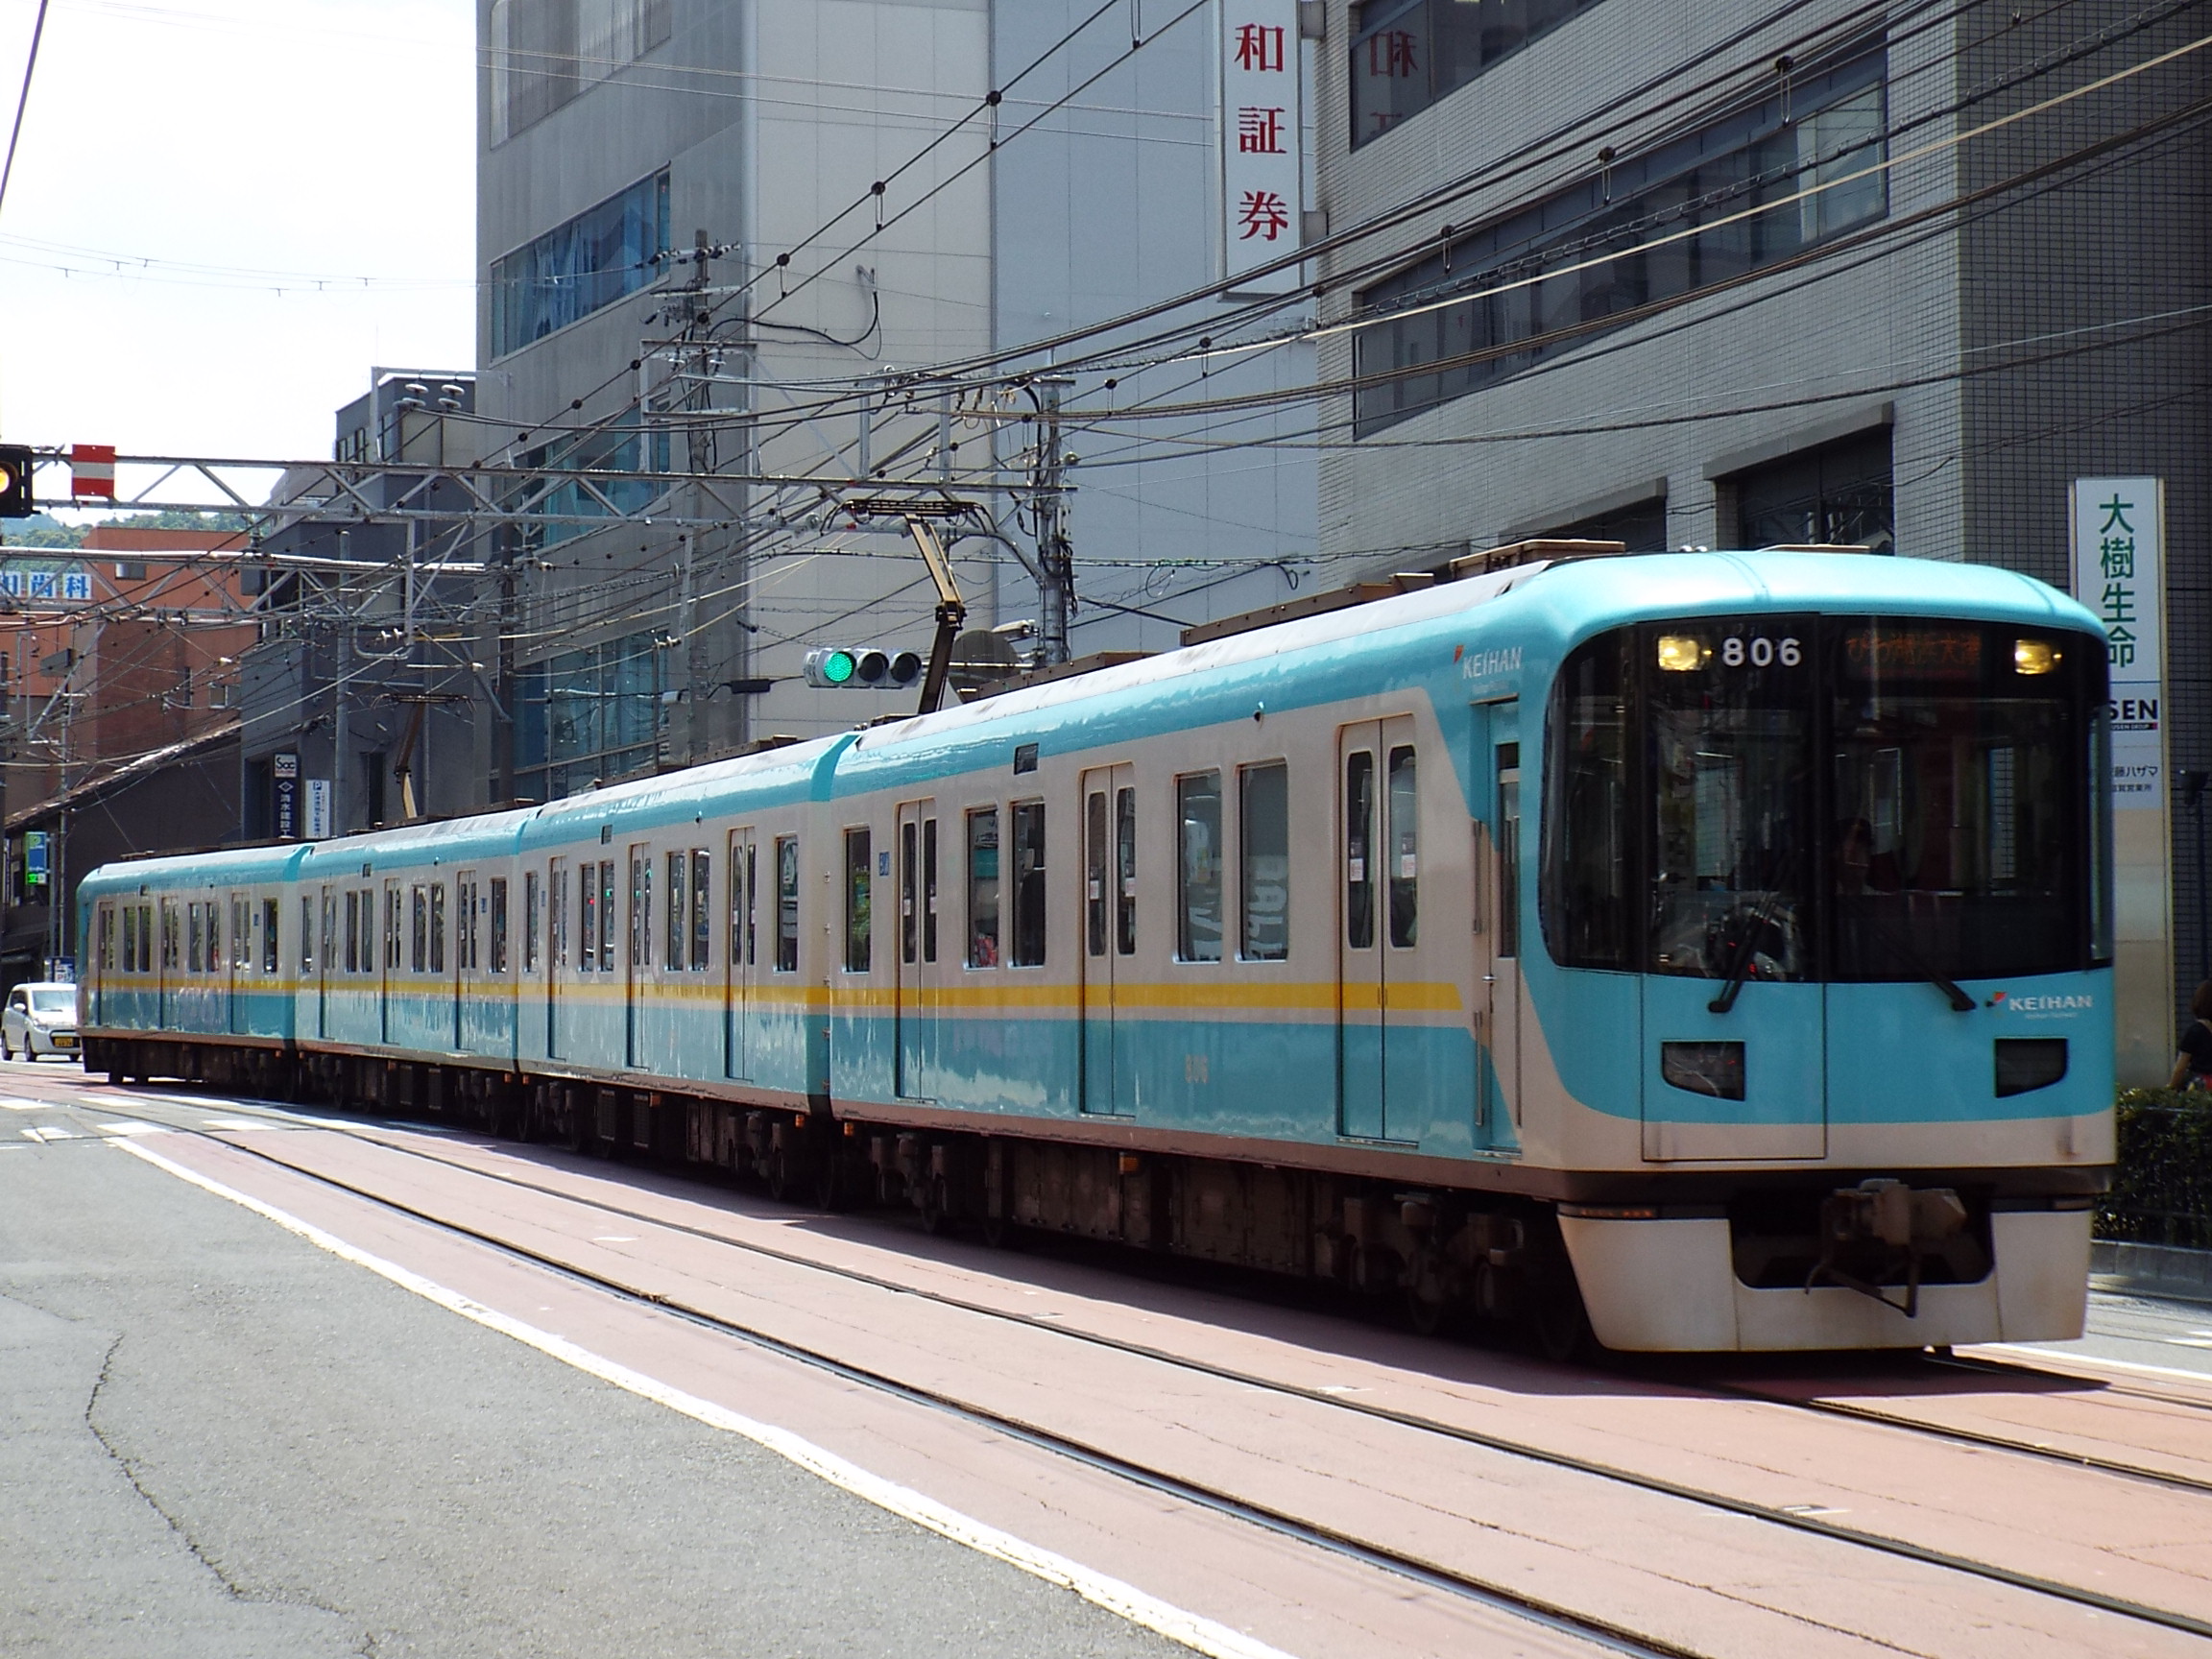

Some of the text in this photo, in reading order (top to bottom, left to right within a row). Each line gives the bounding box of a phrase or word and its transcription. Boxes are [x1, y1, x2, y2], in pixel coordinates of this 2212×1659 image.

[1235, 23, 1288, 241] 和証券
[2100, 493, 2137, 668] 大樹生命
[1462, 646, 1522, 680] KEIHAN
[1720, 637, 1802, 666] 806
[2008, 995, 2093, 1011] KEIHAN
